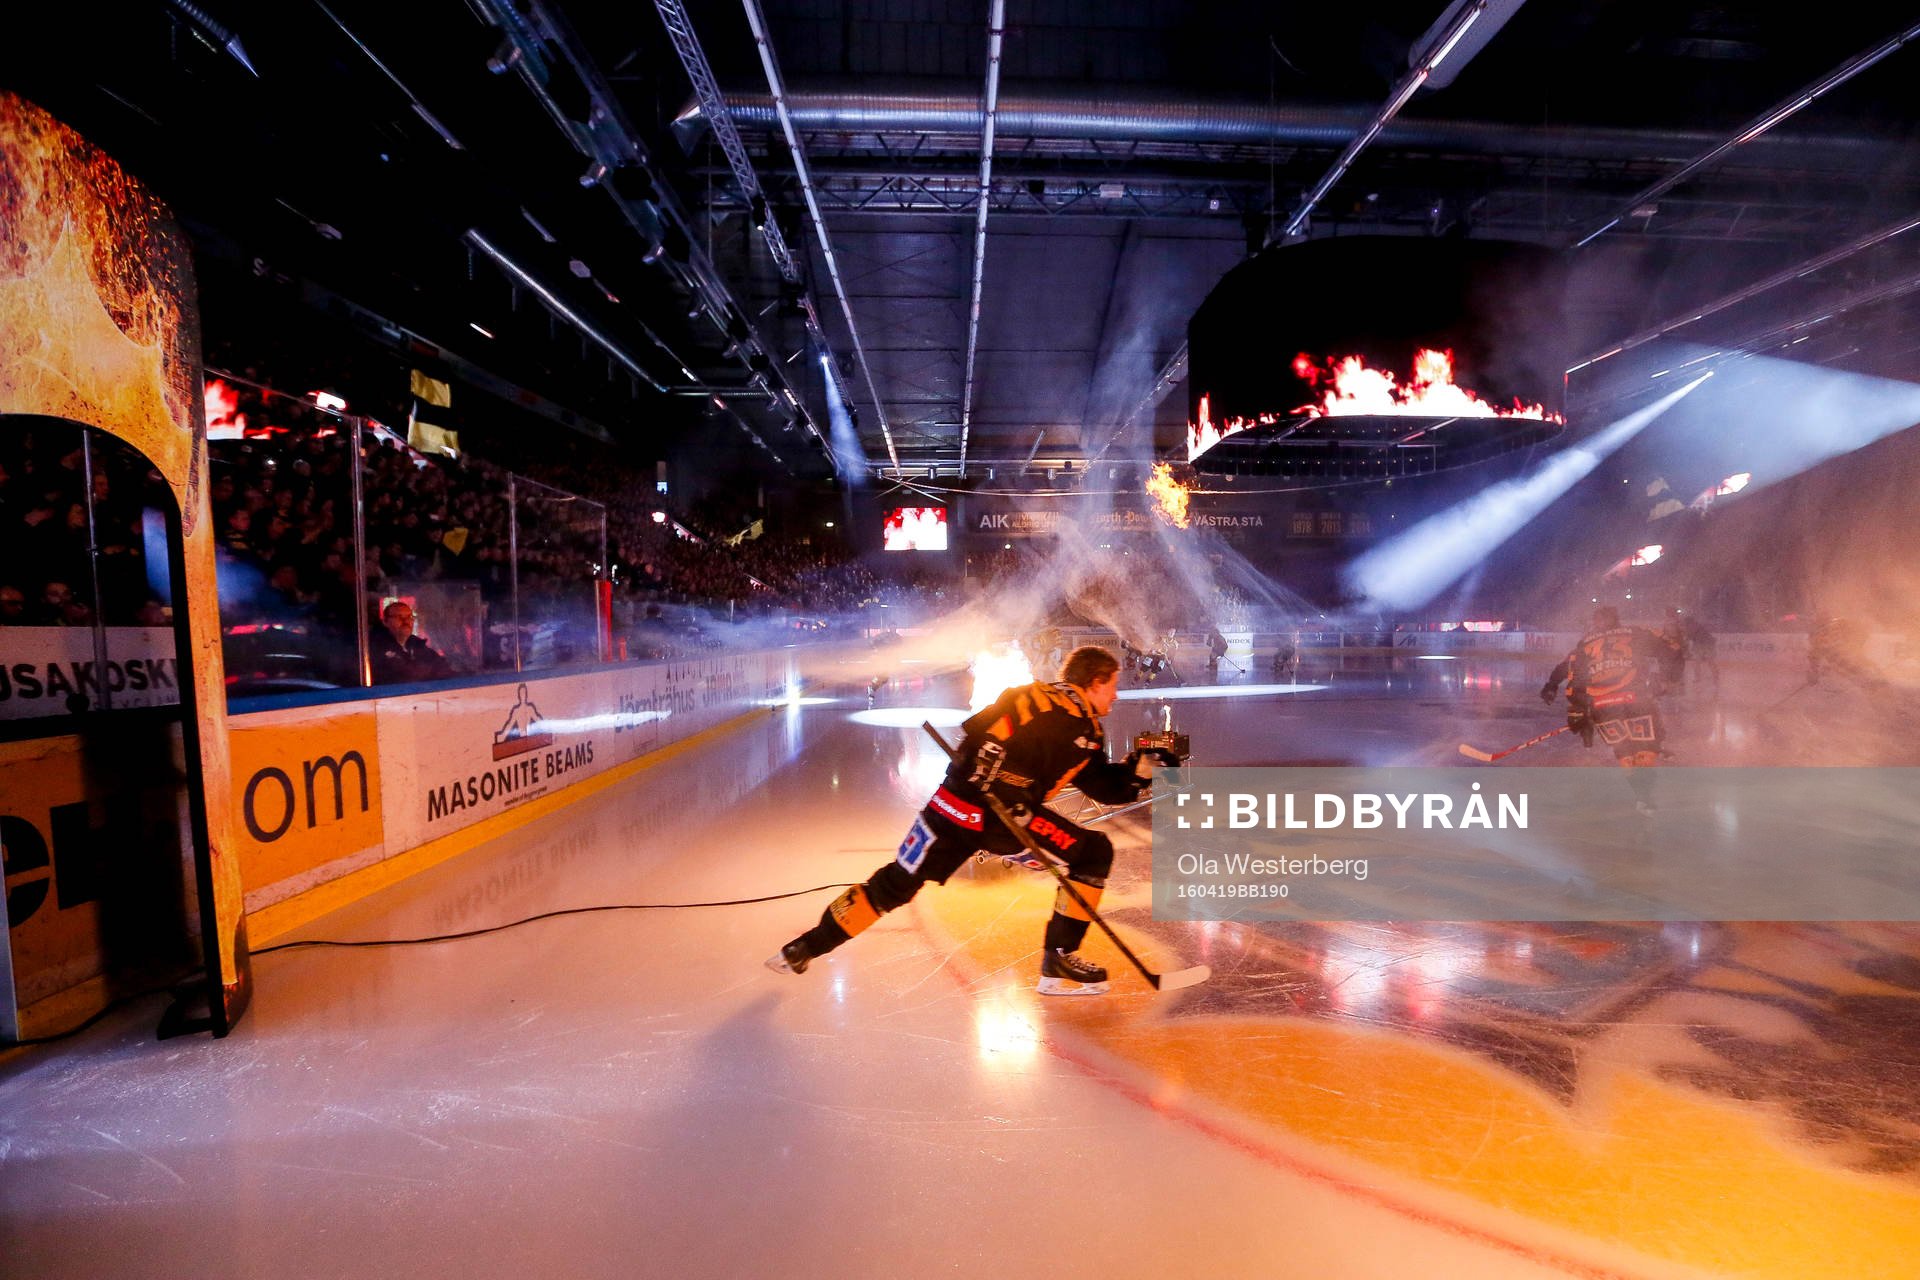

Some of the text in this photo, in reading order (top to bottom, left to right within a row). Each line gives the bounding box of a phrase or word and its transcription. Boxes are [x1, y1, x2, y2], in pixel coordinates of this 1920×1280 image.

[980, 514, 1009, 528] AIK
[1194, 514, 1239, 526] VÄSTRA
[243, 750, 369, 843] om
[427, 740, 594, 822] MASONITE BEAMS
